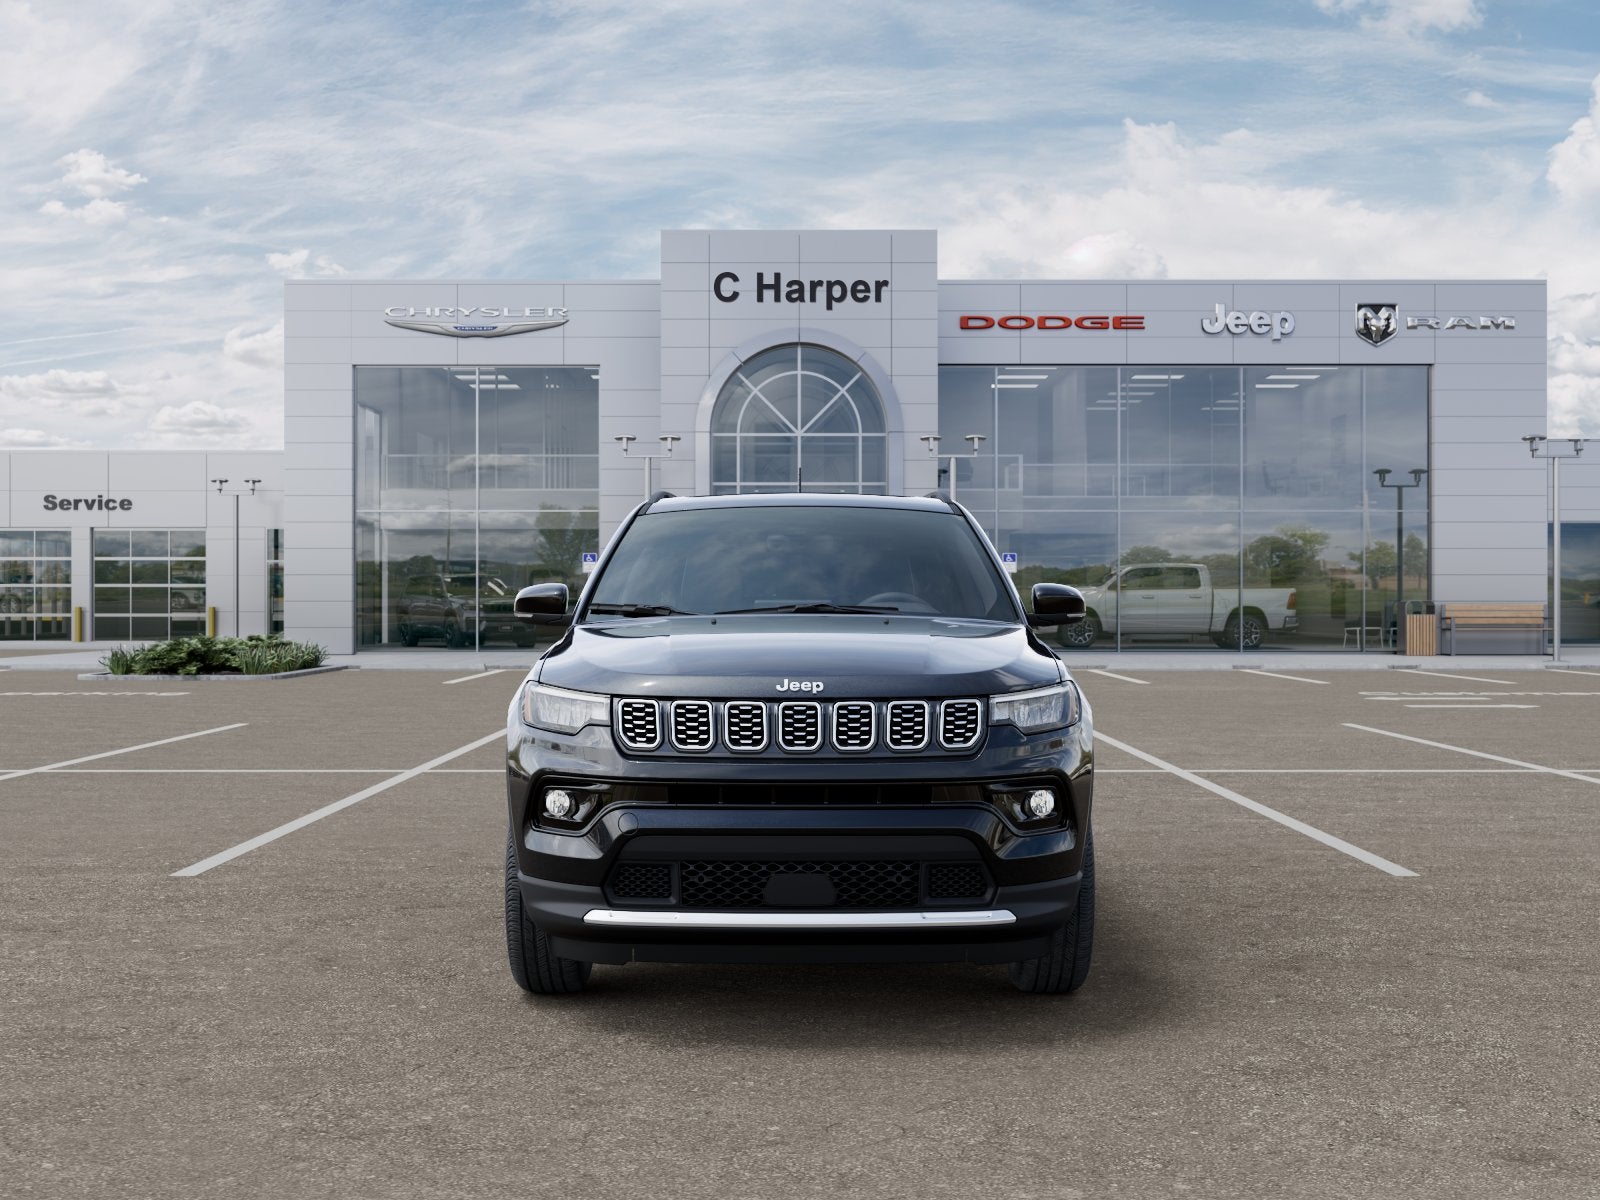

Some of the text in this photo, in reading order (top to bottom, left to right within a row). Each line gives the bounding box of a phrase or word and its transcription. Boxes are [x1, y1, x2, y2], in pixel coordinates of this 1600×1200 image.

[713, 271, 889, 311] C Harper
[384, 306, 569, 318] CHRYSLER
[959, 315, 1146, 330] DODGE
[1201, 303, 1295, 342] Jeep
[1406, 316, 1516, 330] RAM
[43, 494, 133, 511] Service
[776, 679, 824, 694] Jeep
